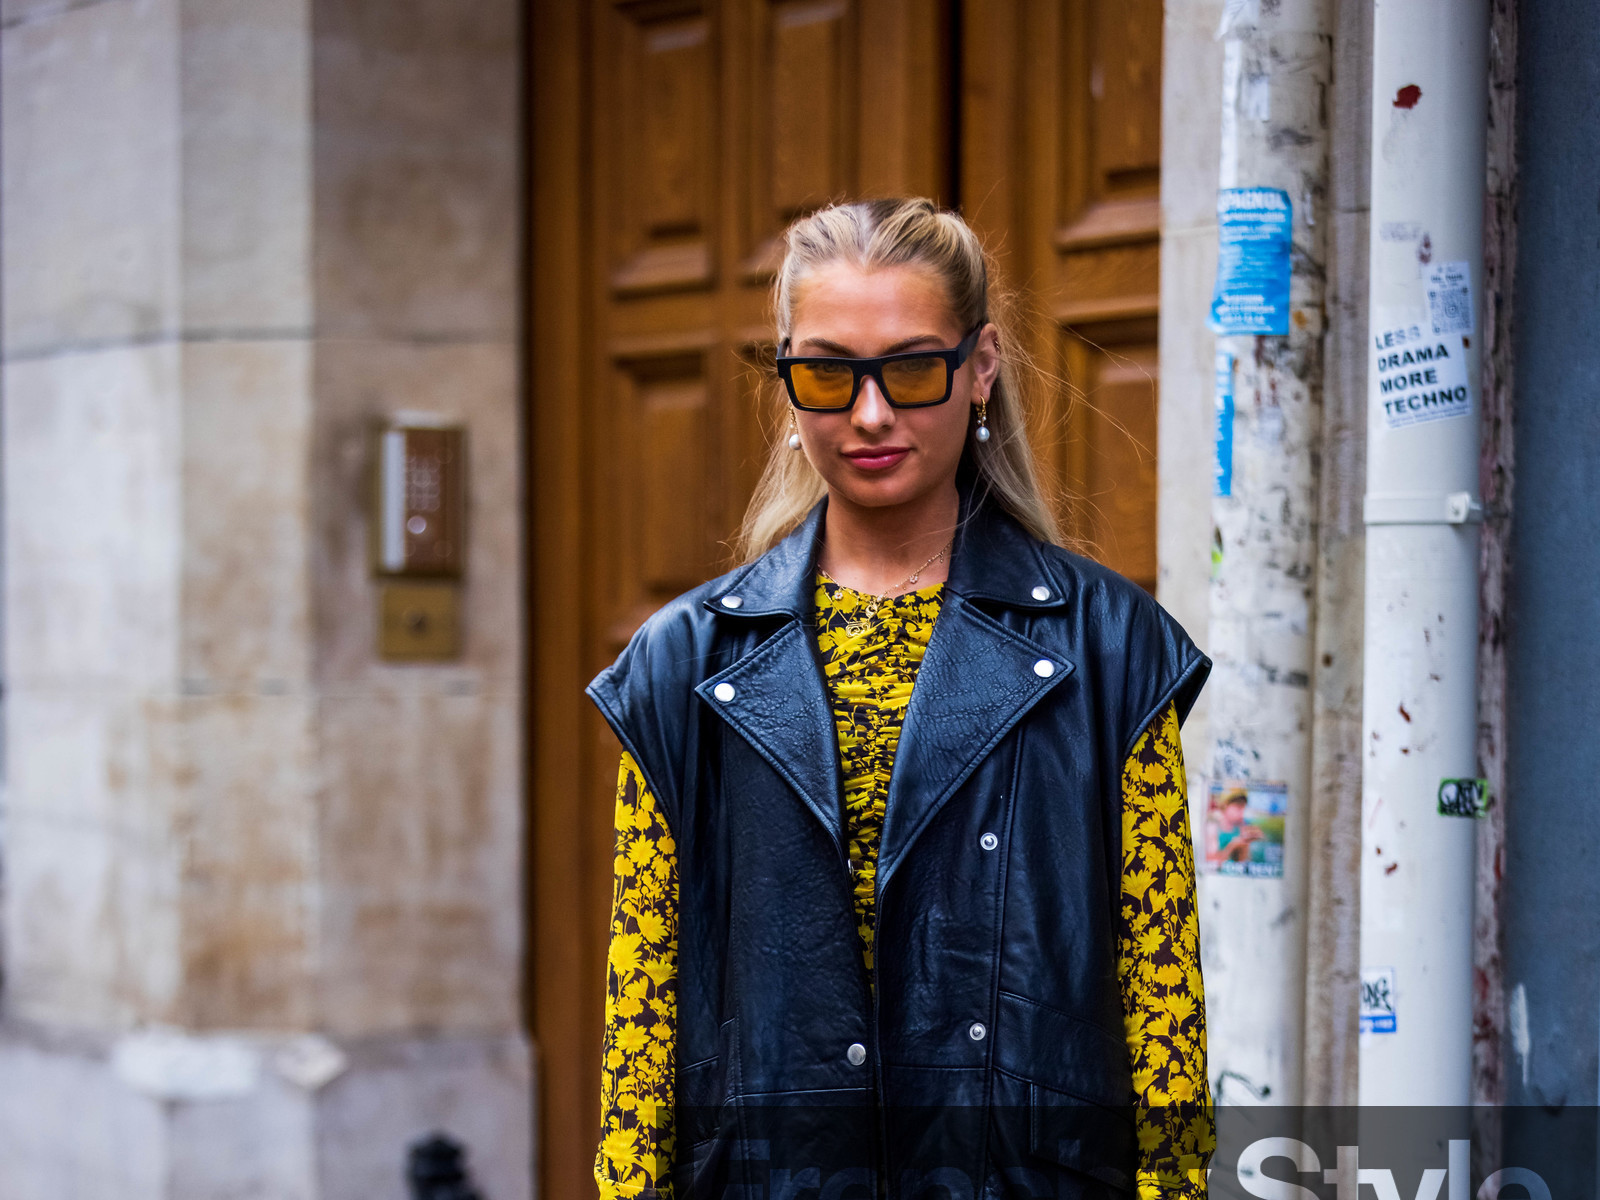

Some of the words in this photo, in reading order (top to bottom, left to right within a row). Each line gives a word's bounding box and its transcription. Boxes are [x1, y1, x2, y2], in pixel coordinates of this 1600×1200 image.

[1376, 326, 1420, 350] LESS
[1378, 343, 1448, 372] DRAMA
[1381, 369, 1438, 394] MORE
[1385, 386, 1467, 415] TECHNO
